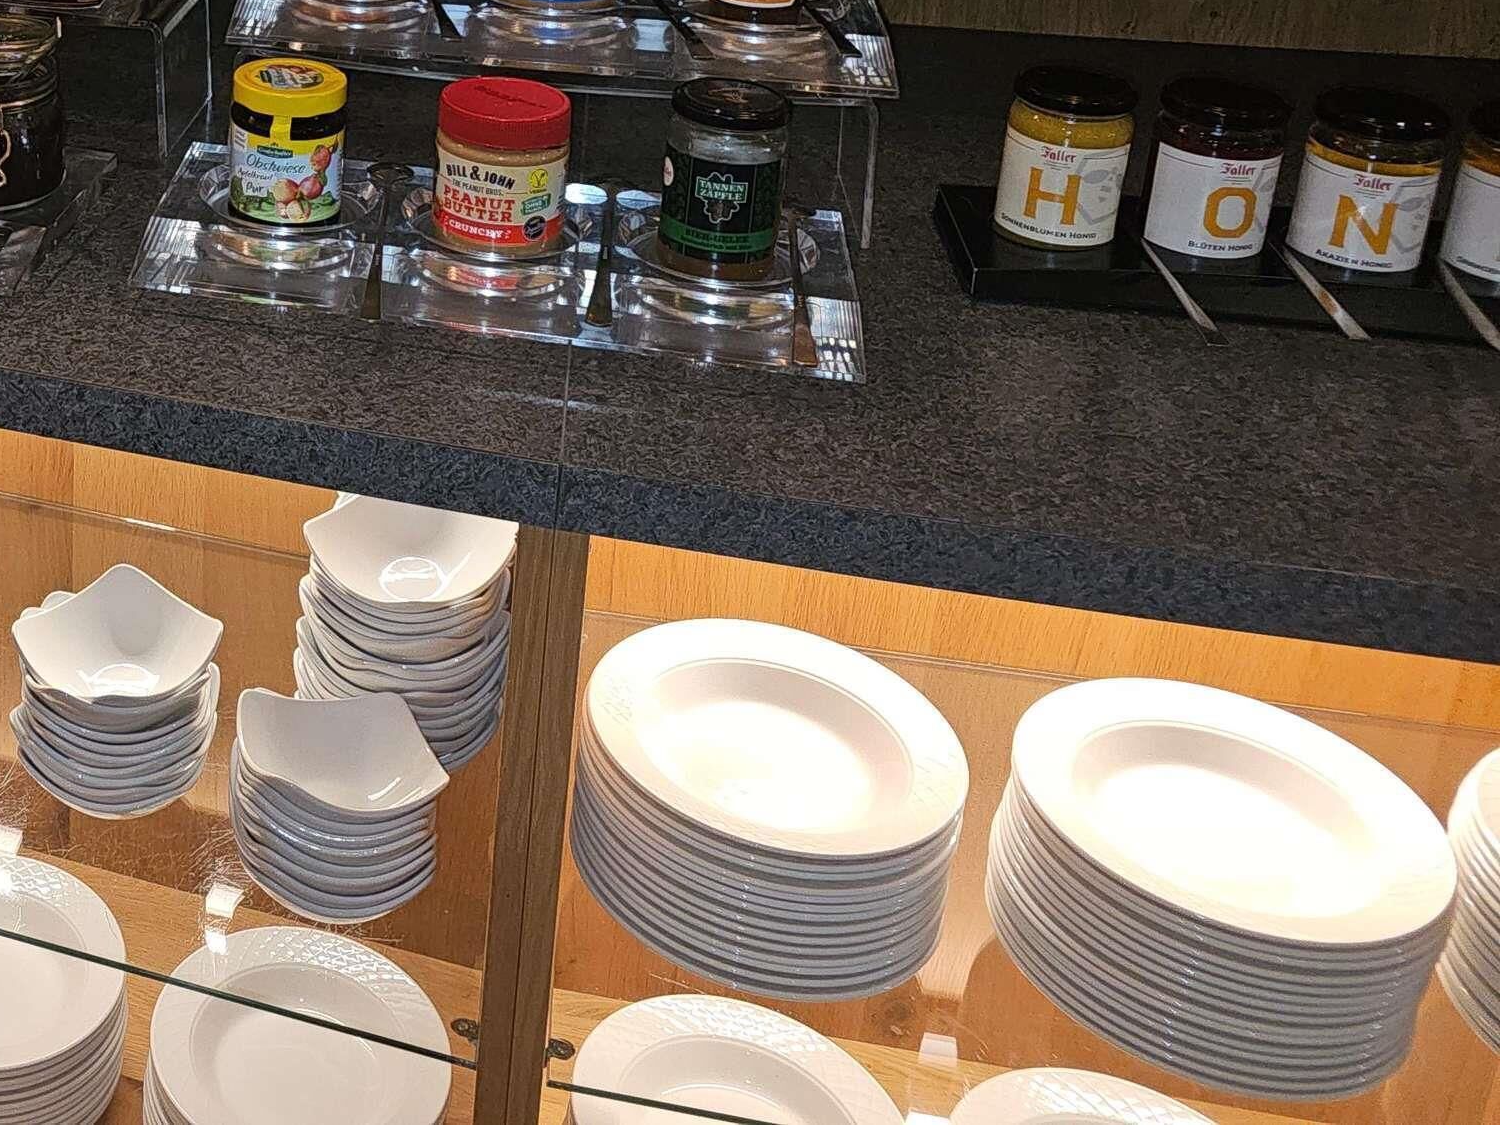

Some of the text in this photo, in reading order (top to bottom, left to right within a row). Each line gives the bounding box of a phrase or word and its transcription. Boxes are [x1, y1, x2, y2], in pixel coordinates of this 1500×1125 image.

[246, 153, 307, 175] Obstwiese
[1041, 145, 1077, 163] Faller
[446, 163, 516, 191] BILL & JOHN
[1220, 162, 1257, 176] Faller
[700, 179, 745, 193] TANNEN
[1353, 174, 1394, 191] Faller
[443, 184, 516, 211] PEANUT
[1023, 166, 1082, 226] H
[443, 198, 512, 223] BUTTER
[1204, 186, 1258, 239] O
[449, 219, 504, 239] CRUNCHY
[1328, 193, 1397, 256] N
